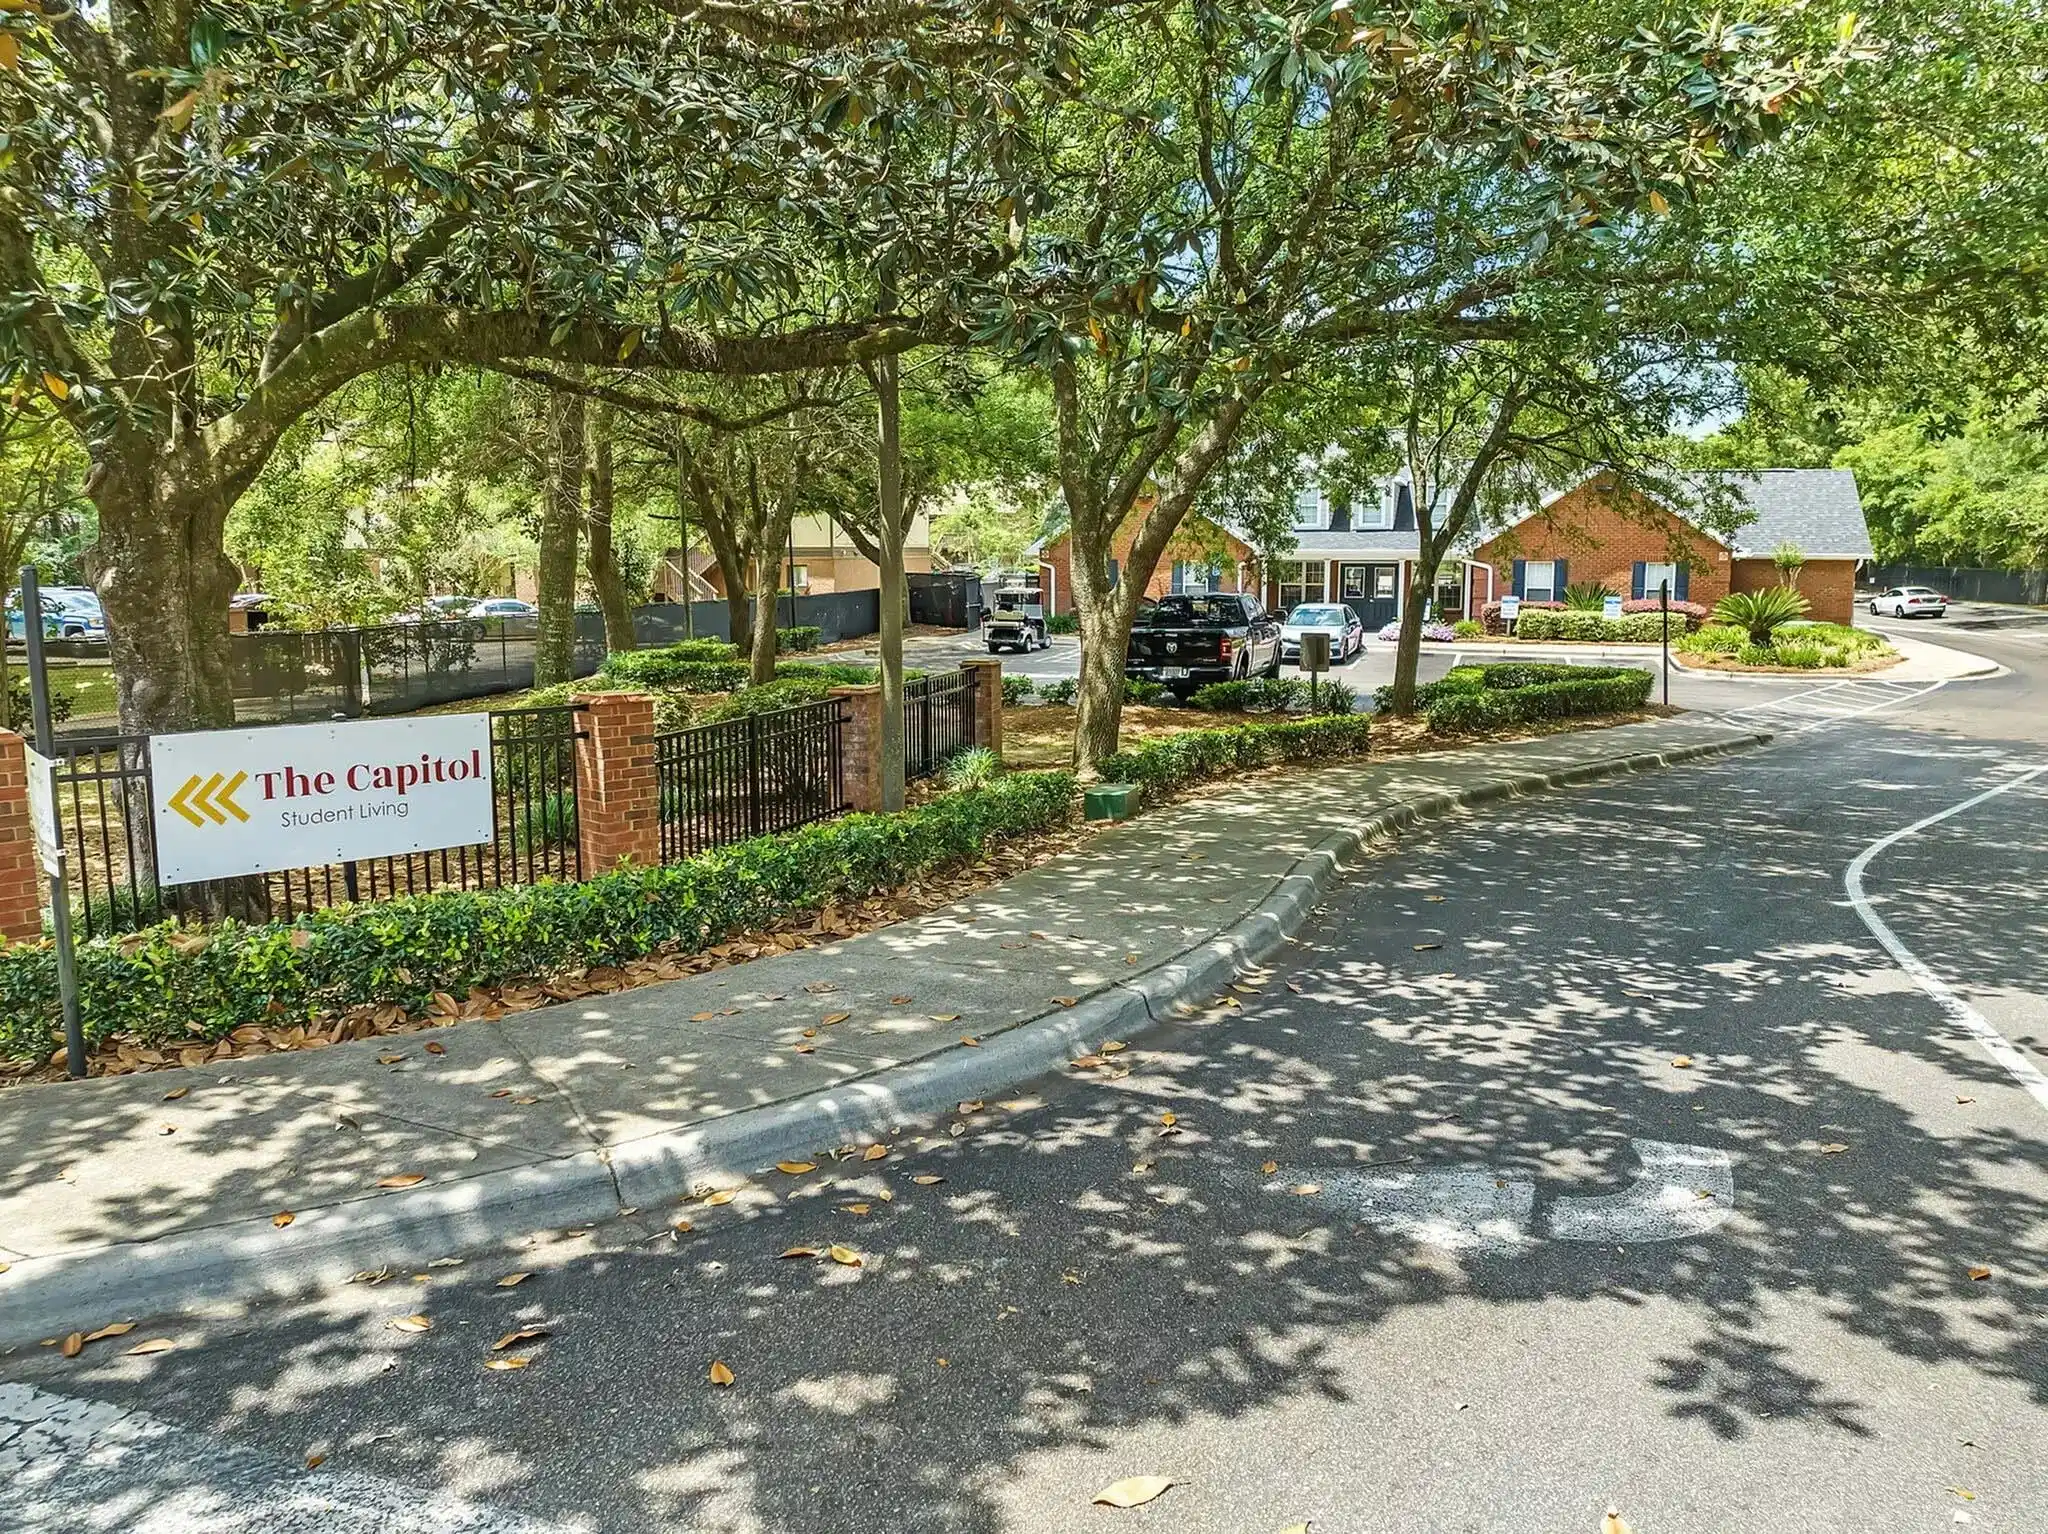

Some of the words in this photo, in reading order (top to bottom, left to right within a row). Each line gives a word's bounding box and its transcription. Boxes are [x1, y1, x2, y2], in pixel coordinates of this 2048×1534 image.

[255, 766, 336, 801] The
[347, 749, 481, 795] Capitol
[281, 804, 354, 828] Student
[359, 801, 409, 819] Living
